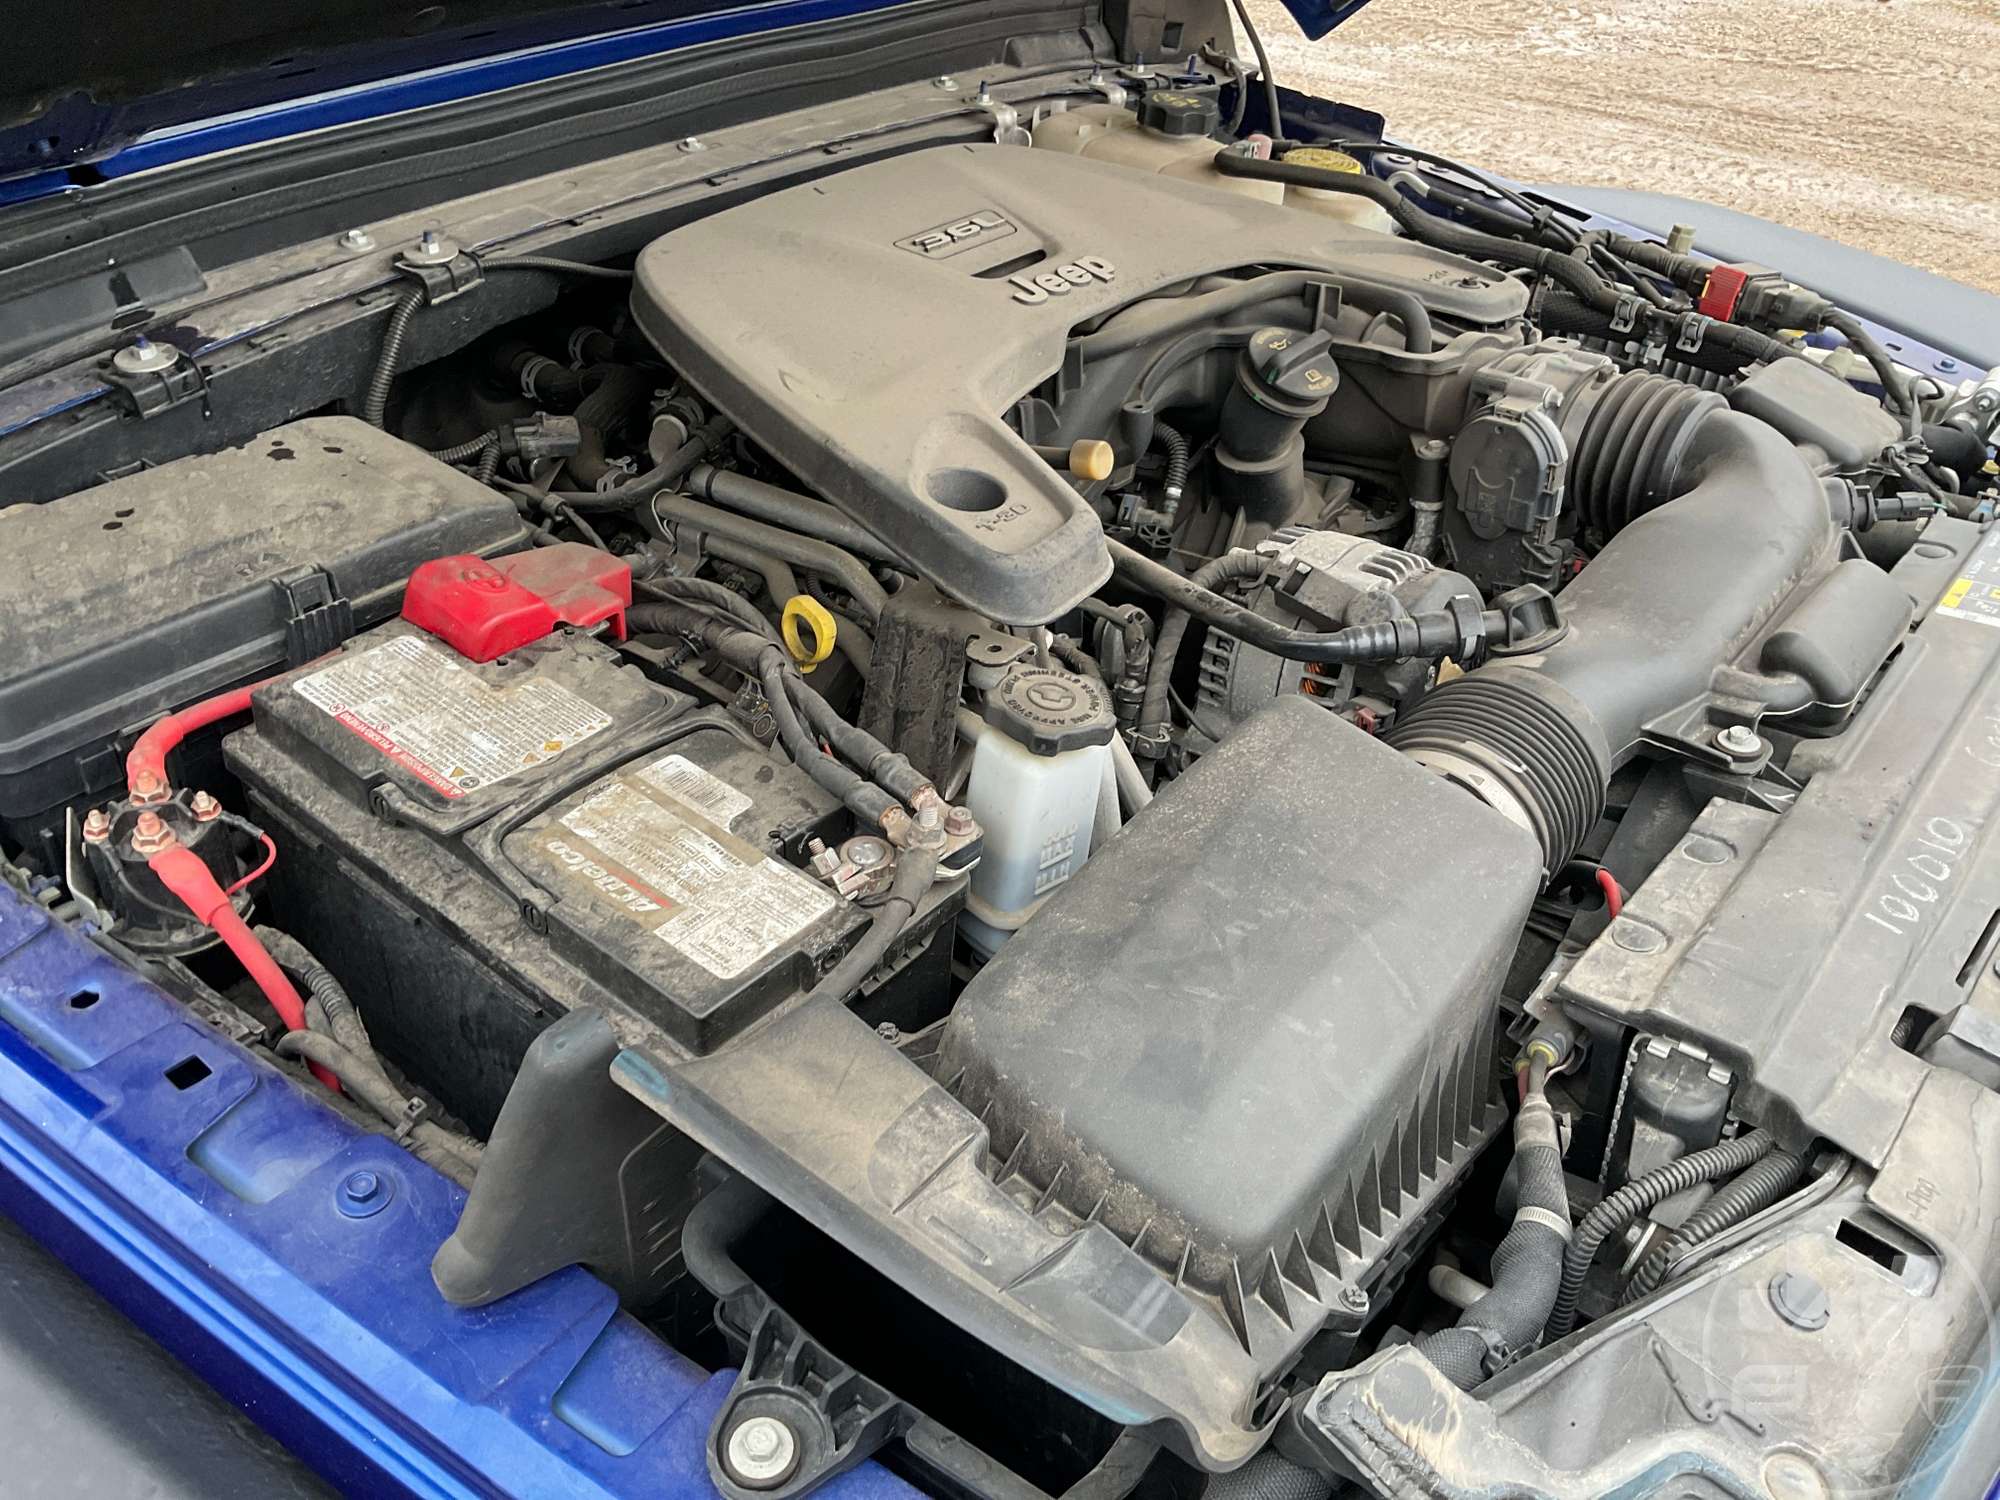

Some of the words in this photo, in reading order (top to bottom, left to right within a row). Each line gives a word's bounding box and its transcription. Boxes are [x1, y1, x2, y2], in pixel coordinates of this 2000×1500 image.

[1008, 255, 1116, 306] Jeep
[1040, 835, 1076, 861] MAX
[548, 838, 663, 913] ACDelco
[1036, 861, 1071, 889] MIN
